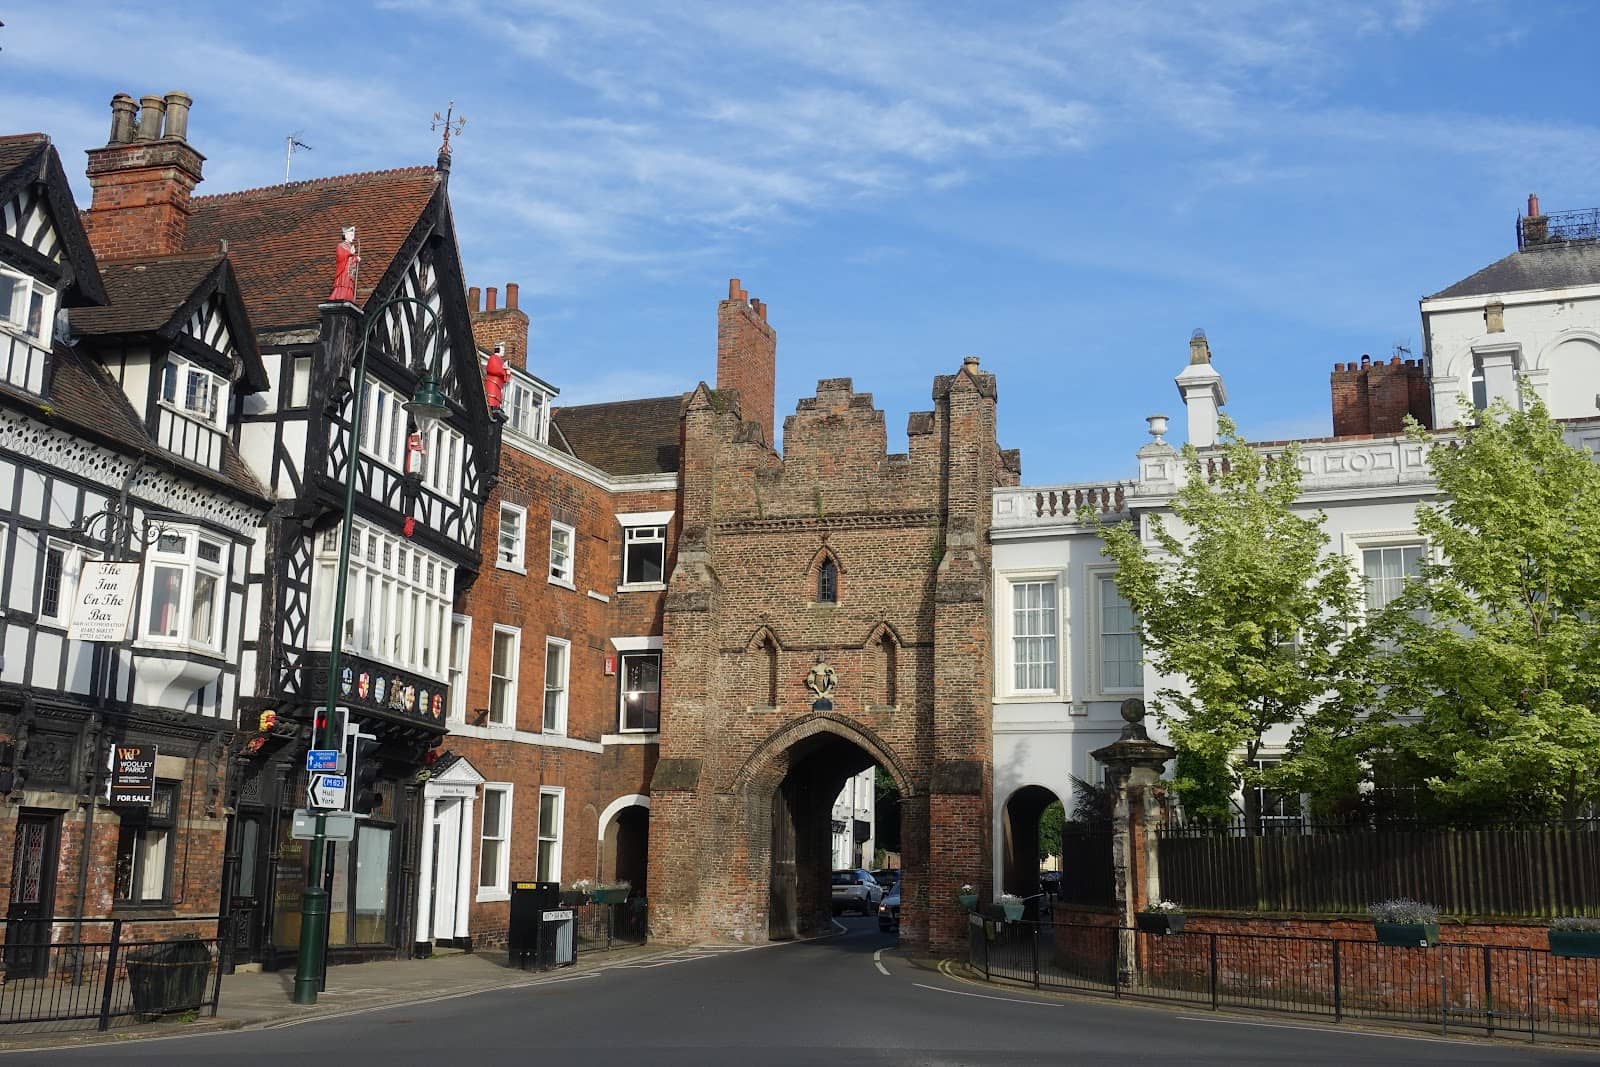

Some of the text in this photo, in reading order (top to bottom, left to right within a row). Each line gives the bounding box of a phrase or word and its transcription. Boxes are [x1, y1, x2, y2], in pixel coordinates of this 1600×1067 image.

[99, 564, 121, 575] The
[96, 579, 117, 590] Inn
[84, 594, 124, 605] On The
[88, 609, 111, 620] Bar
[323, 777, 344, 787] (M62)
[116, 794, 131, 802] FOR
[321, 797, 334, 805] York
